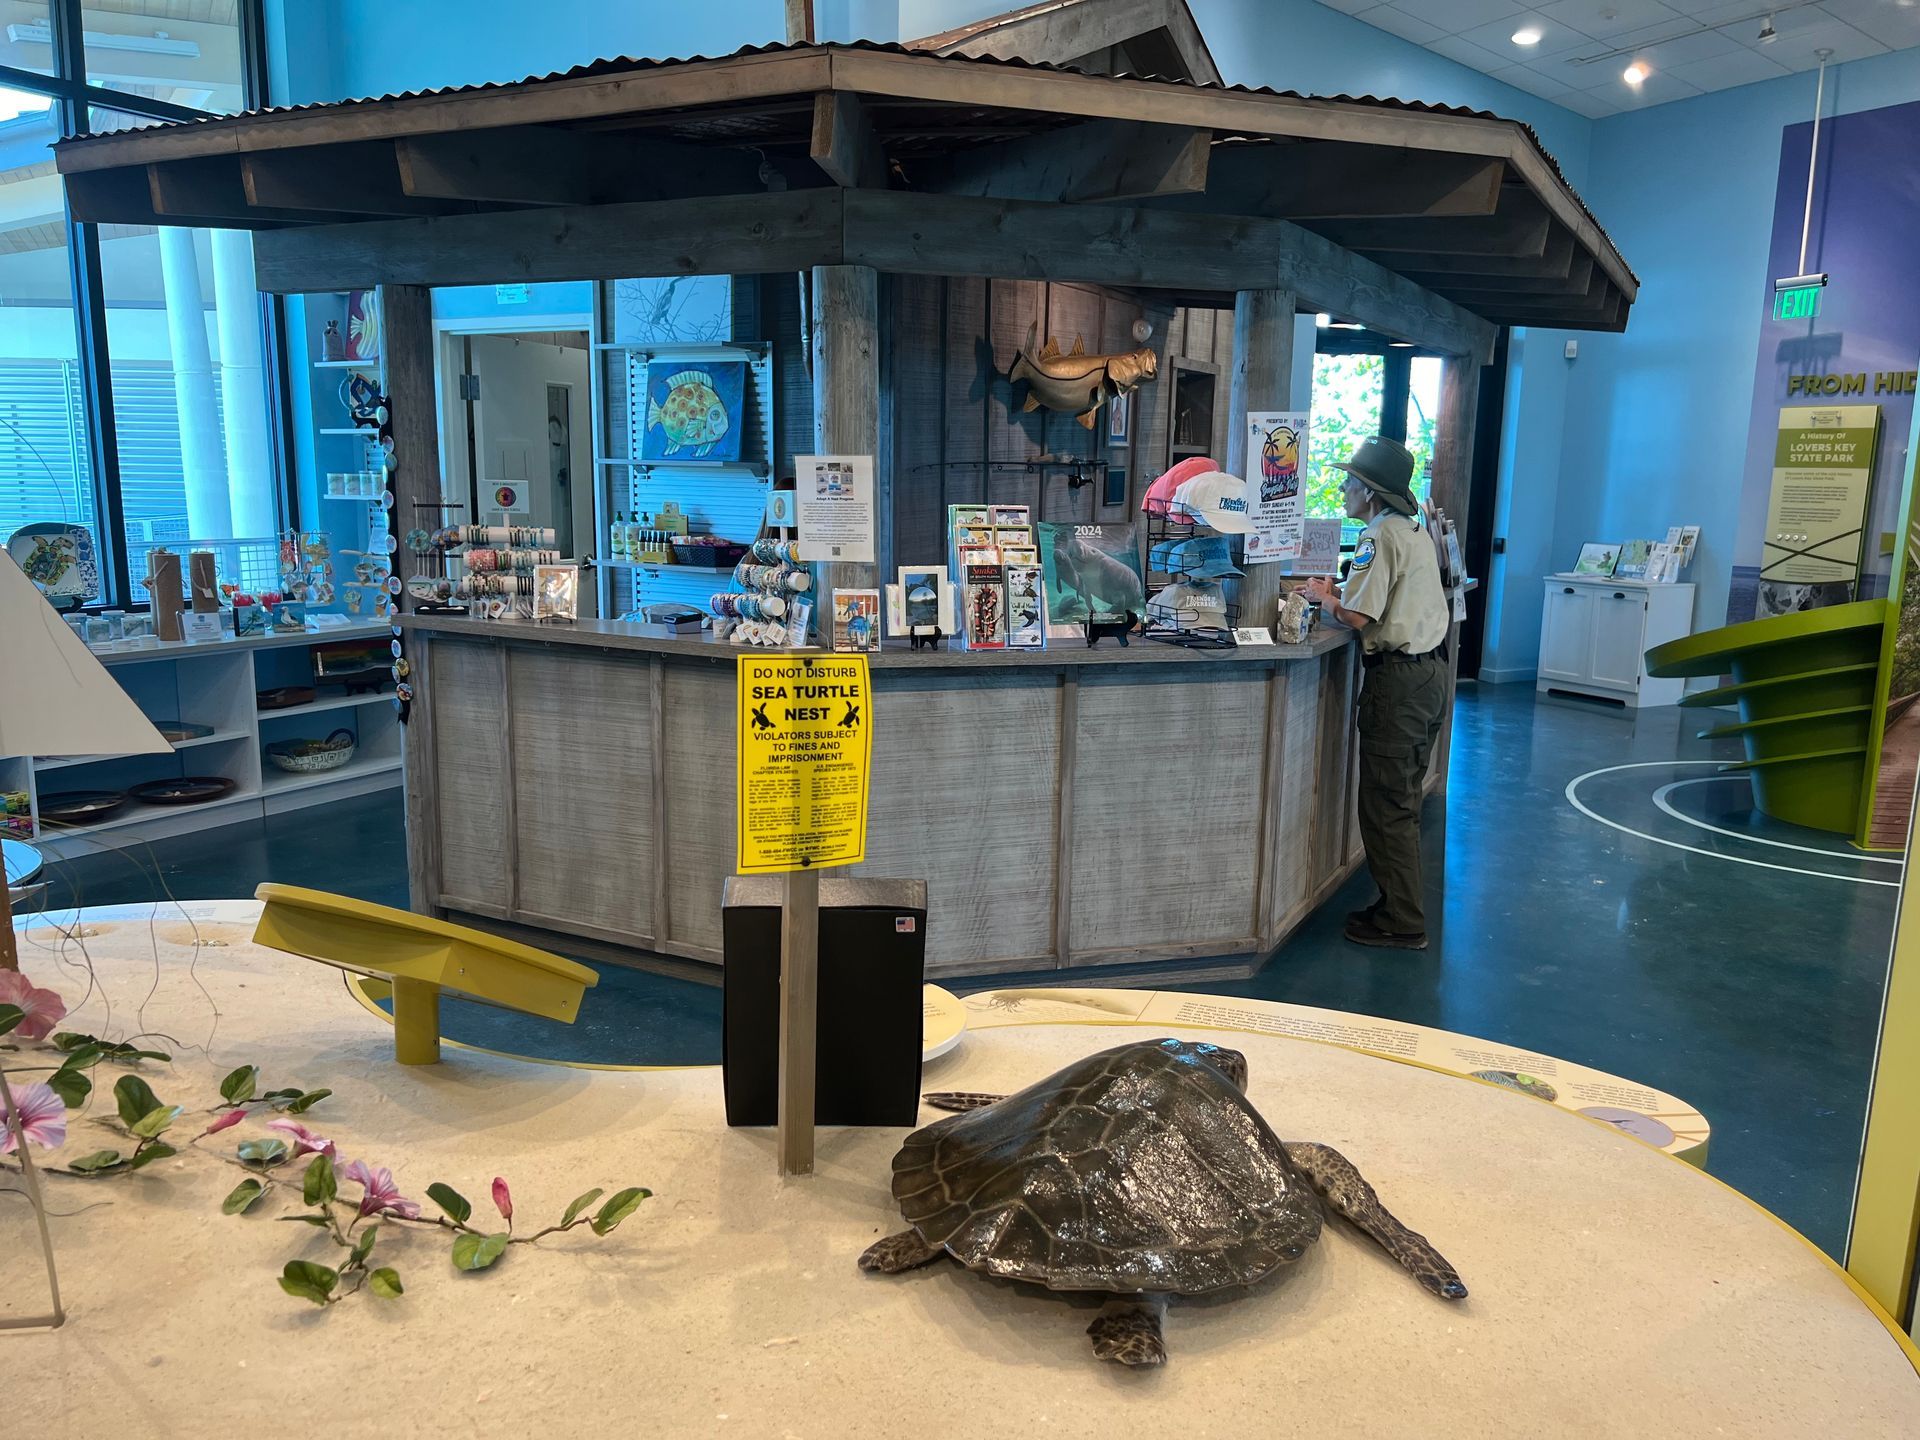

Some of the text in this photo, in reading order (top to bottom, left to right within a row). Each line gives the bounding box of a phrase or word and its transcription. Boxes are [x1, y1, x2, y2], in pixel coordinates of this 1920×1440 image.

[1781, 287, 1818, 319] EXIT
[1787, 373, 1866, 397] FROM
[1790, 443, 1857, 452] LOVERS KEY
[1790, 453, 1854, 463] STATE PARK
[1074, 525, 1102, 536] 2024
[972, 565, 997, 575] Snakes
[753, 667, 857, 678] DO NOT DISTURB
[752, 685, 860, 699] SEA TURTLE
[785, 707, 830, 721] NEST
[754, 730, 858, 741] VIOLATORS SUBJECT
[773, 741, 840, 751] TO FINES AND
[768, 752, 844, 763] IMPRISONMENT
